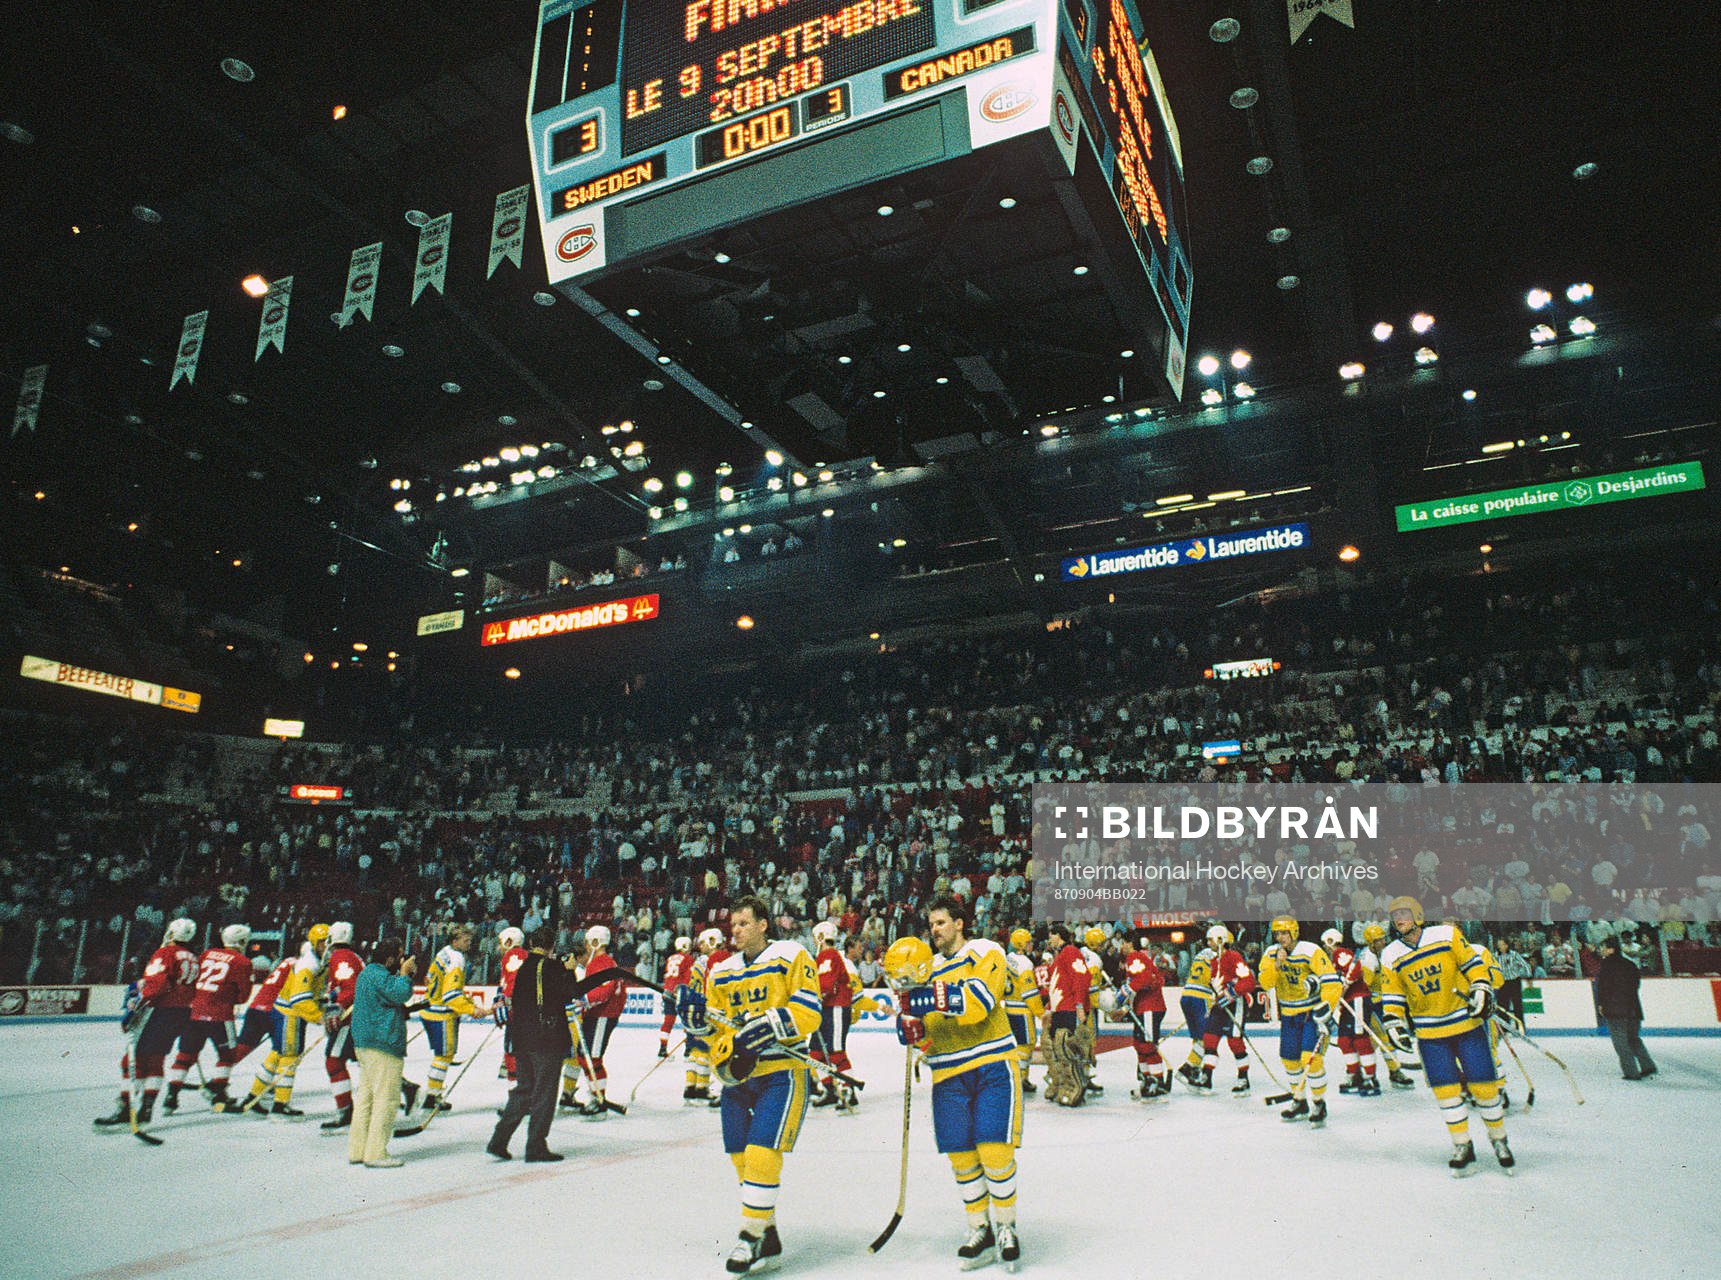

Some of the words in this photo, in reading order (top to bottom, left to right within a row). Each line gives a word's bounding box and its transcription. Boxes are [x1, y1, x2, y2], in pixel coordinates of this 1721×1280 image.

[900, 36, 973, 92] CANADA
[626, 79, 663, 119] LE
[679, 64, 701, 98] 9
[828, 88, 843, 113] 3
[581, 120, 597, 153] 3
[724, 107, 791, 159] 0:00
[806, 112, 847, 132] PERIODE
[564, 161, 653, 210] SWEDEN
[1411, 508, 1428, 522] La
[1433, 501, 1479, 519] caisse
[1484, 488, 1559, 515] populaire
[1597, 470, 1688, 497] Desjardins
[1208, 527, 1304, 559] Laurentide
[1090, 546, 1180, 577] Laurentide
[506, 602, 629, 641] McDonald's
[57, 663, 134, 699] BEEFEATER
[196, 959, 231, 991] 22
